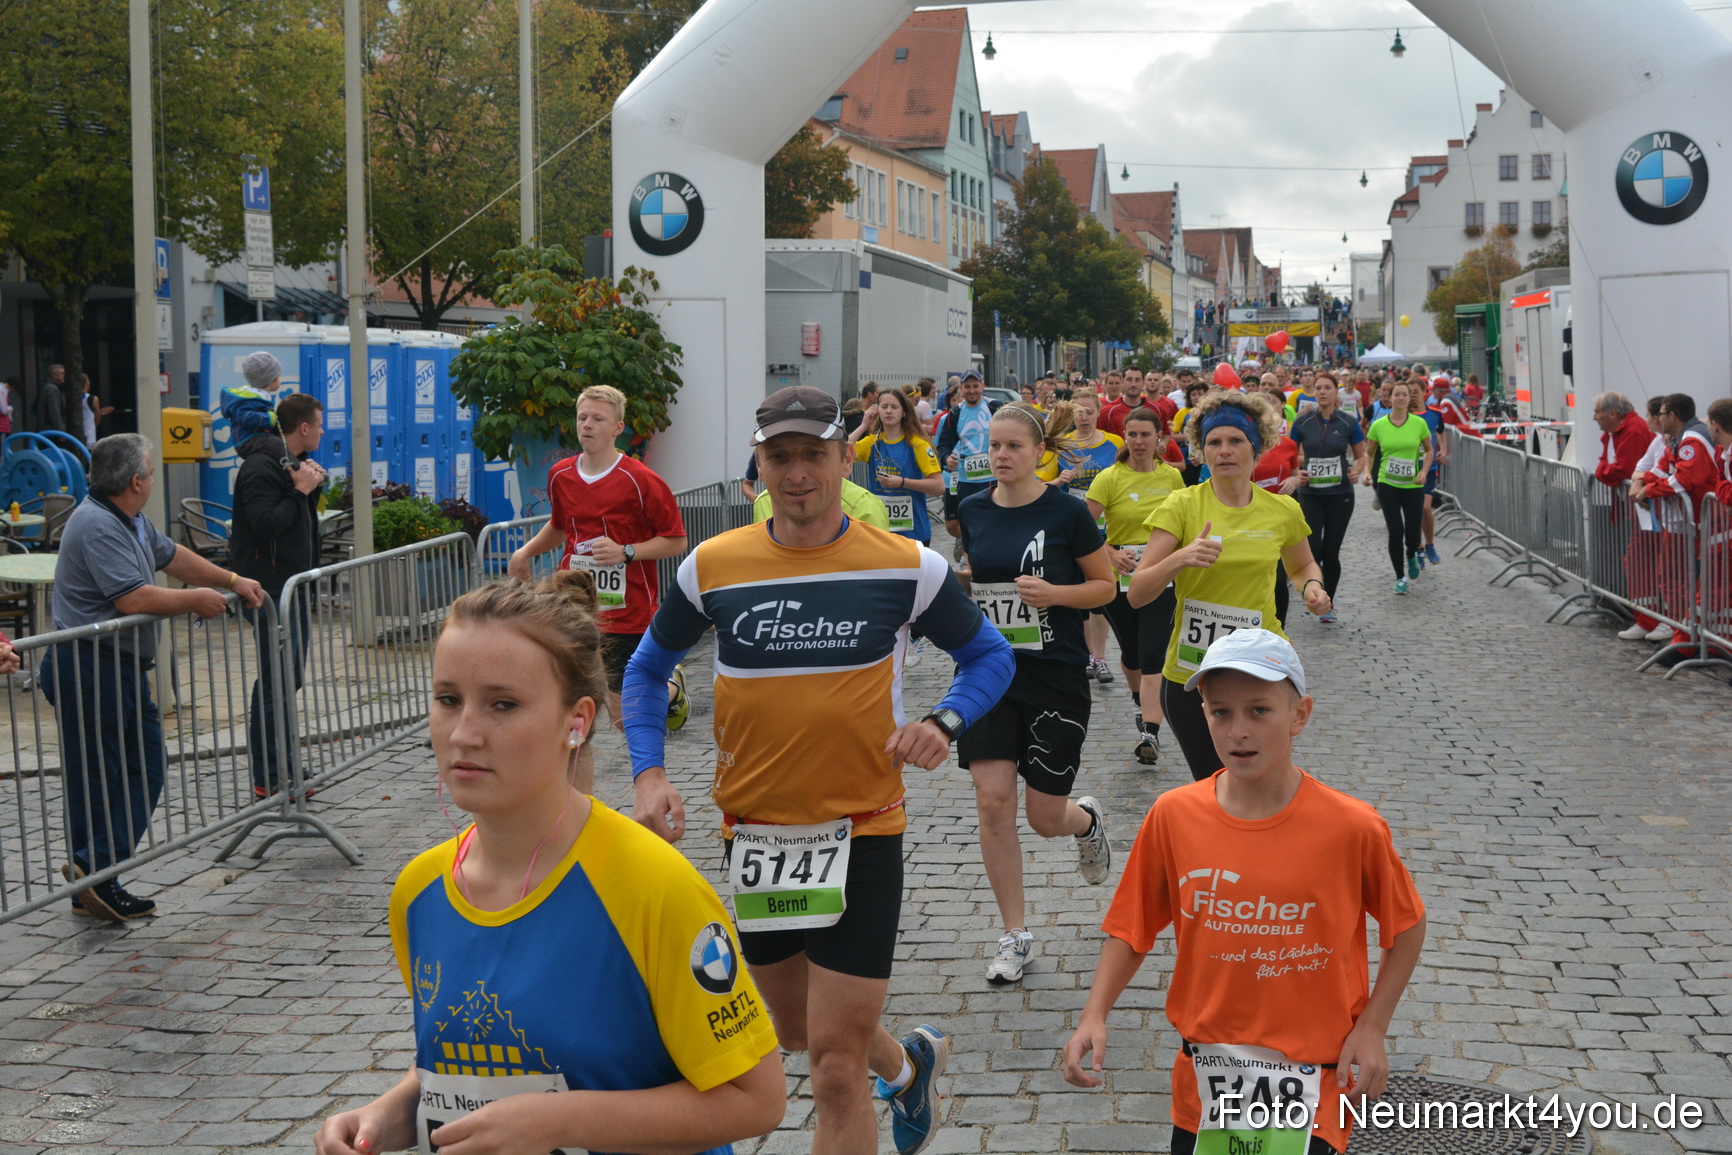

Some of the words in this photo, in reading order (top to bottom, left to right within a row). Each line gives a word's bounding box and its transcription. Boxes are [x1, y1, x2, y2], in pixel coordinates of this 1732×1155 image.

[1622, 133, 1702, 166] BMW
[633, 173, 698, 202] BMW
[191, 322, 199, 342] 3
[966, 459, 989, 472] 5142
[1310, 464, 1338, 476] 5217
[1388, 463, 1412, 476] 5516
[977, 599, 1031, 625] 5174
[1184, 604, 1209, 617] PARTL
[1211, 611, 1249, 624] Neumarkt
[754, 616, 868, 640] Fischer
[1187, 616, 1250, 647] 517
[764, 638, 859, 651] AUTOMOBILE
[736, 833, 772, 846] PARTL
[774, 832, 830, 846] Neumarkt
[741, 846, 839, 888] 5147
[767, 894, 808, 914] Bernd
[1193, 890, 1317, 921] Fischer
[1203, 919, 1305, 936] AUTOMOBILE
[1250, 946, 1277, 961] das
[1195, 1055, 1229, 1068] PARTL
[1229, 1056, 1293, 1072] Neumarkt
[1207, 1074, 1305, 1123] 5148
[1228, 1135, 1264, 1155] Chris
